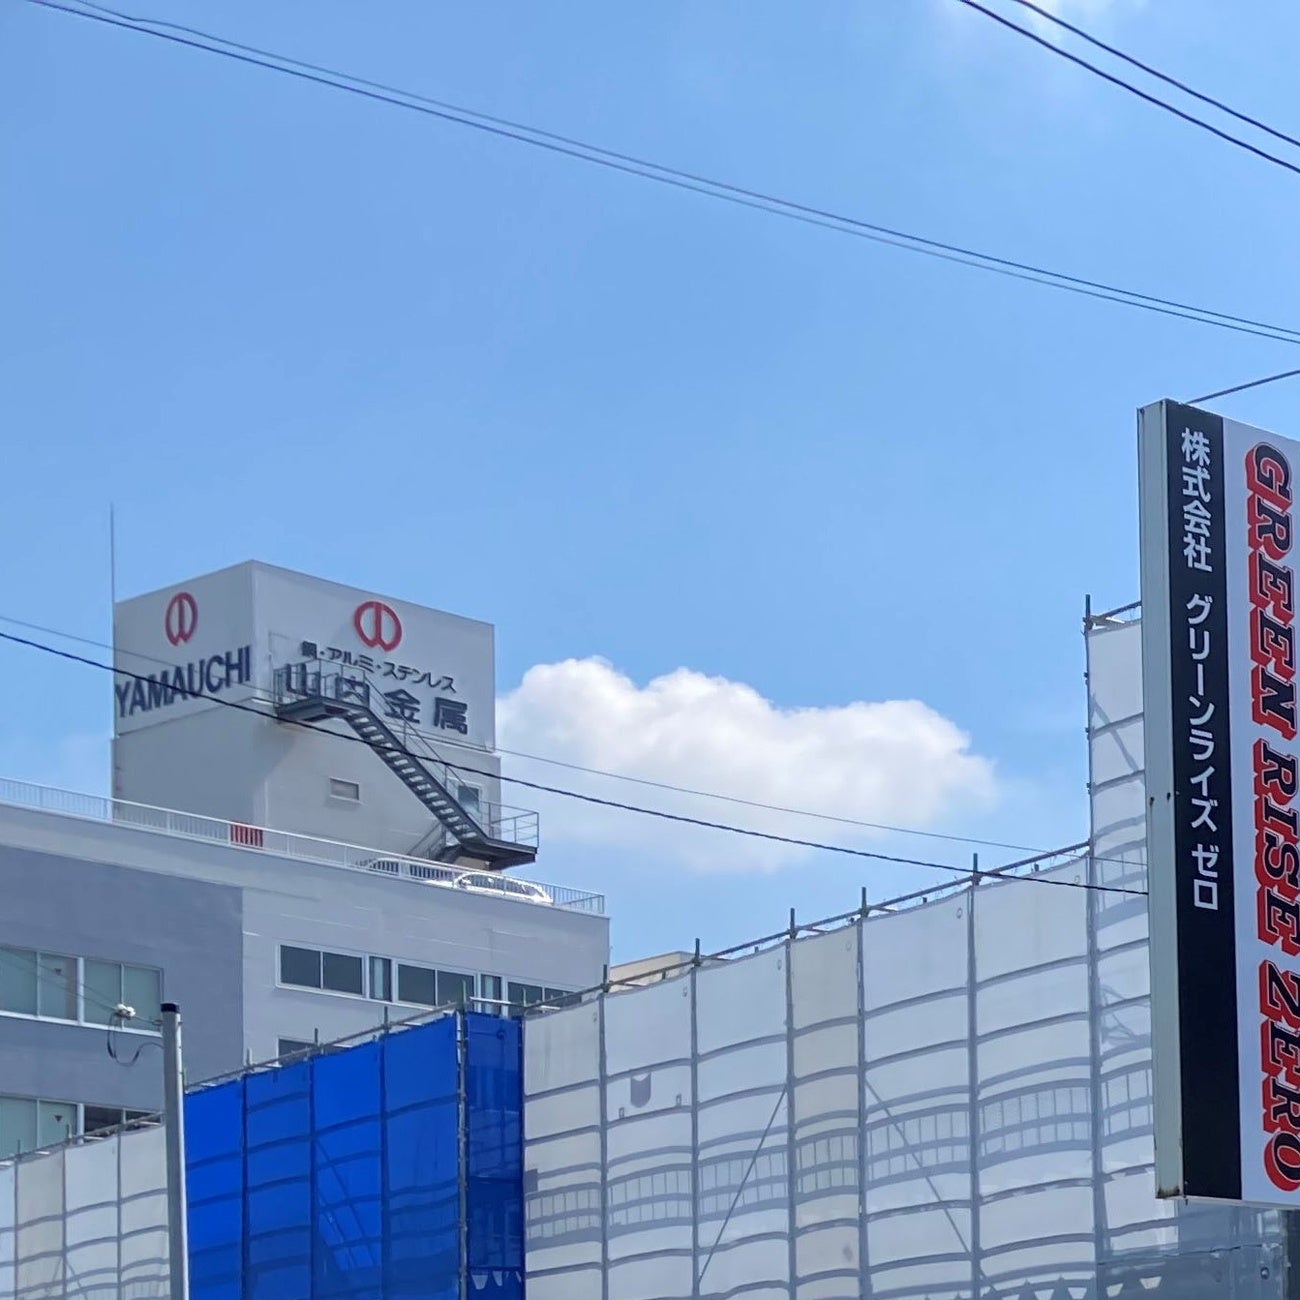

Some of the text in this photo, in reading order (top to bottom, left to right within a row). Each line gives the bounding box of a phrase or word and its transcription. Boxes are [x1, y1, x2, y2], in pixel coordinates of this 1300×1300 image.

[114, 644, 252, 717] YAMAUCHI
[1181, 427, 1220, 911] 株式会社 グリーンライズ ゼロ
[1245, 441, 1298, 741] GREEN
[285, 662, 468, 735] 山内金属
